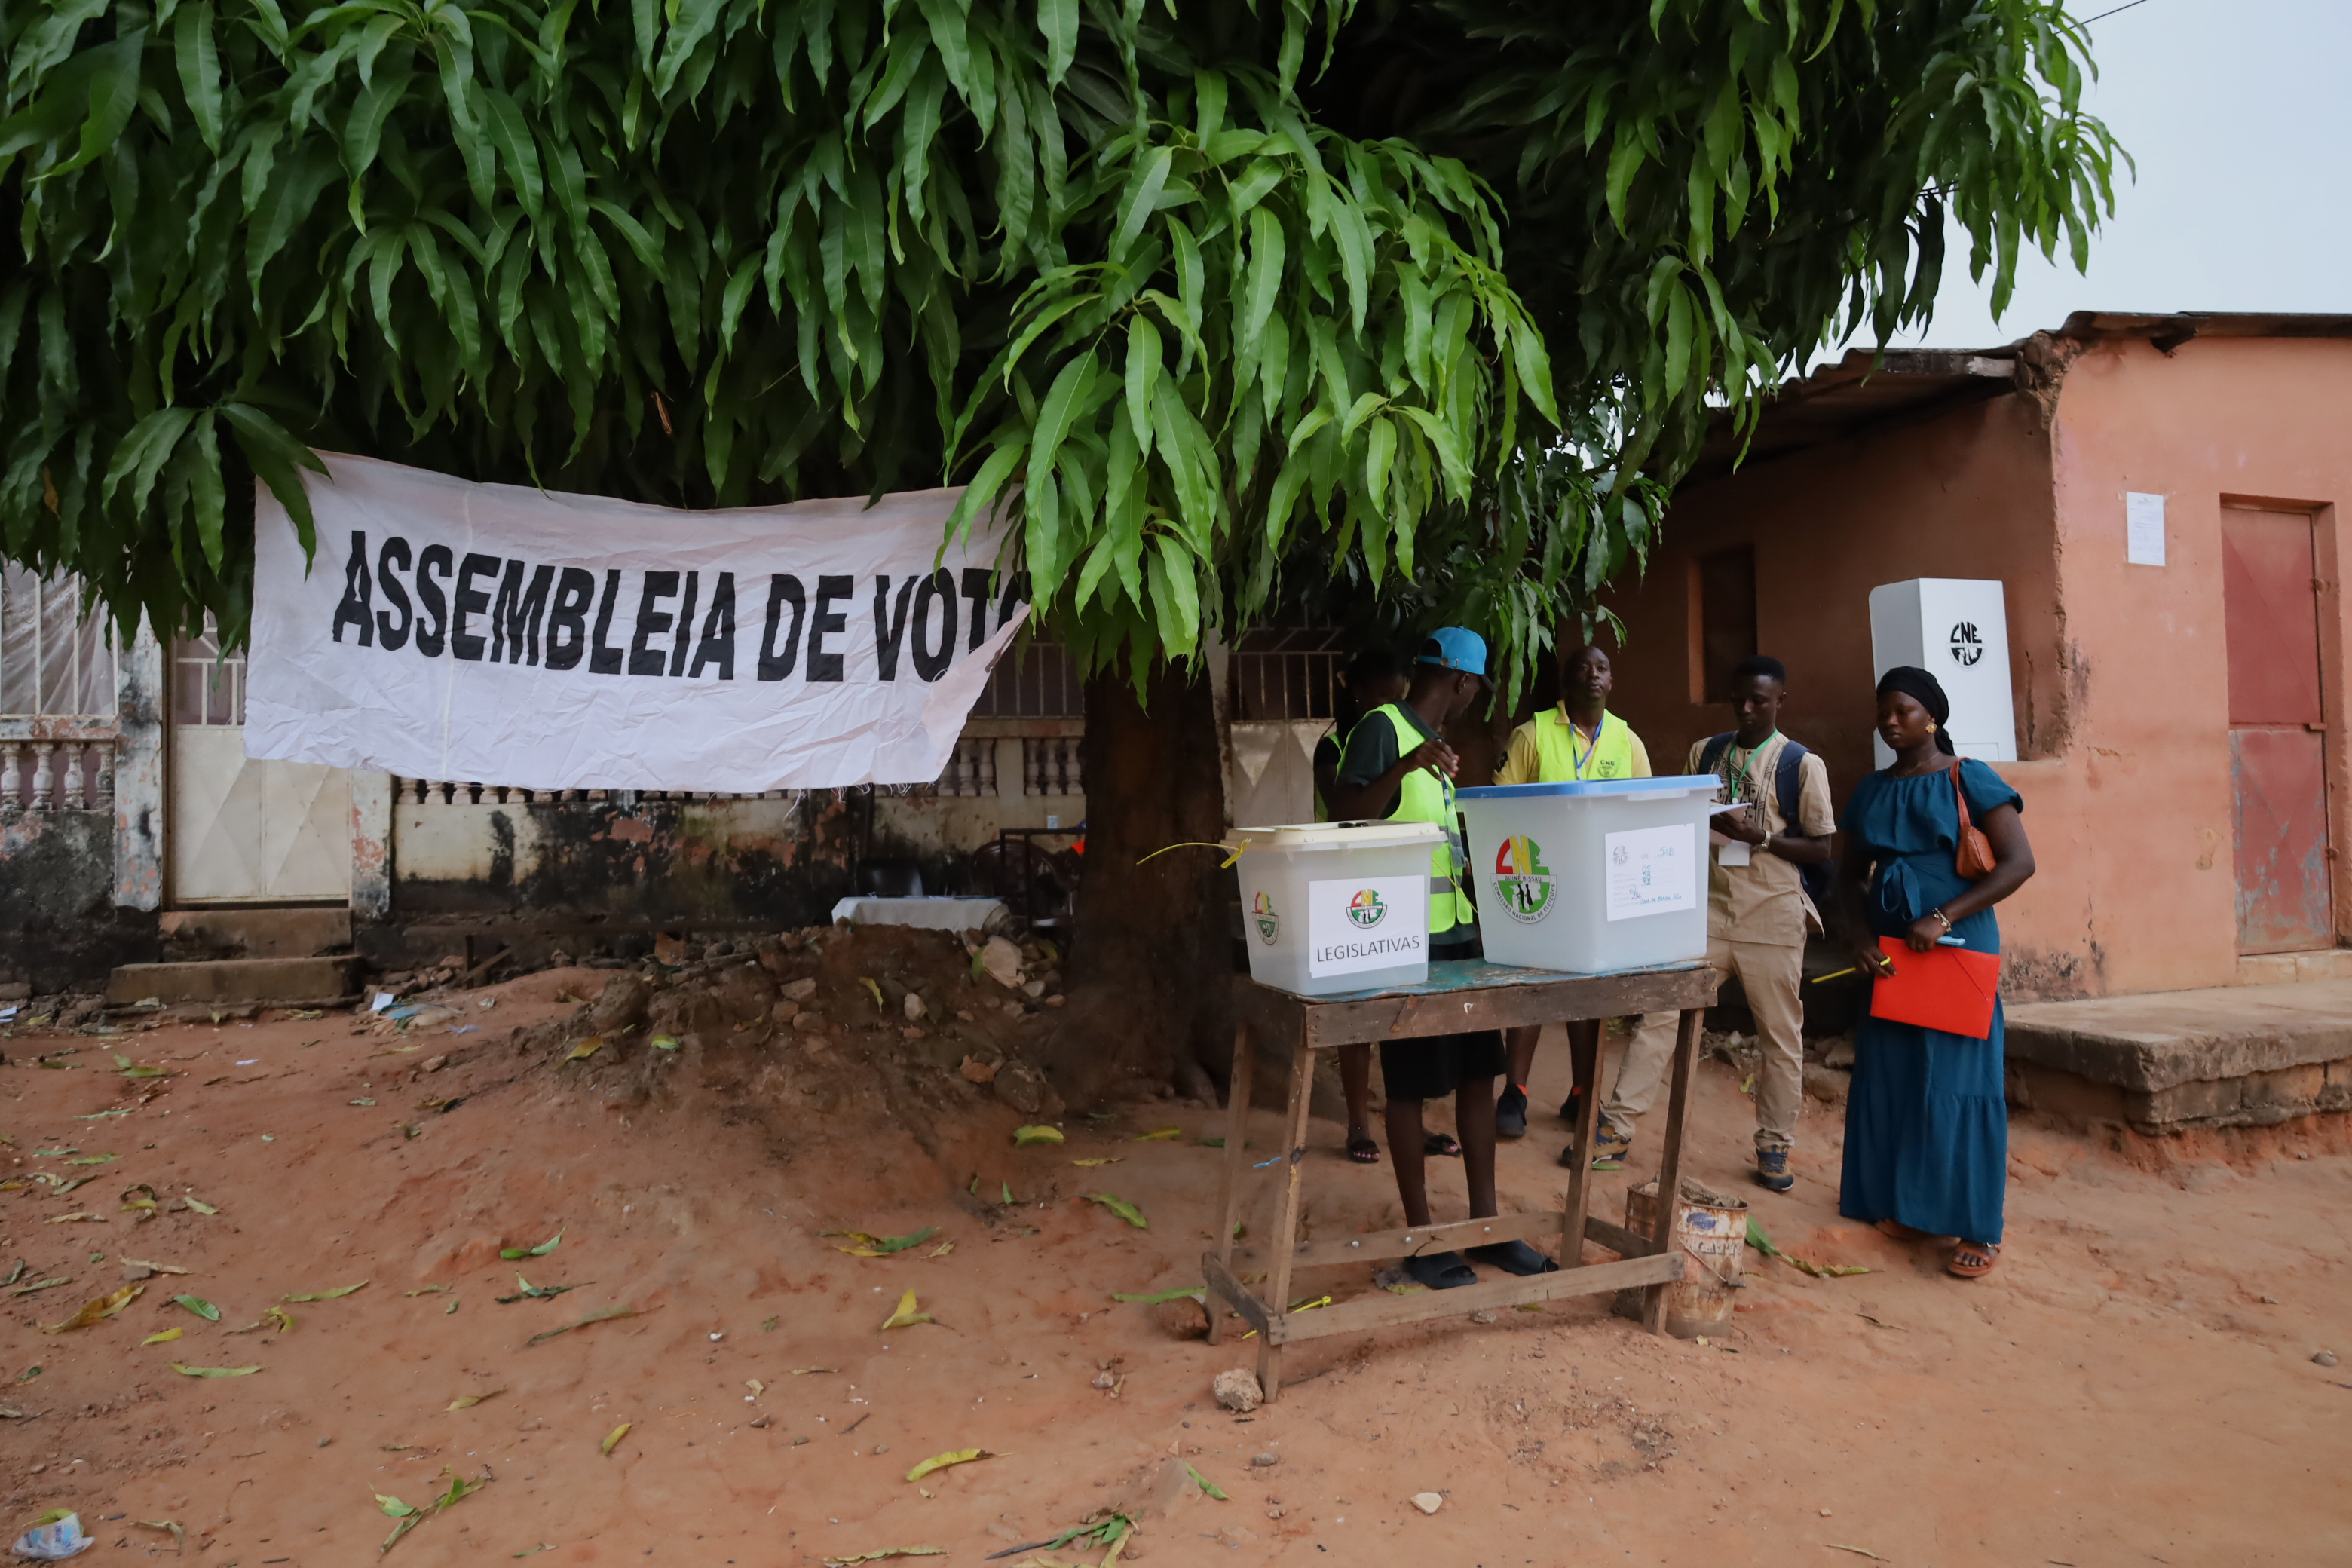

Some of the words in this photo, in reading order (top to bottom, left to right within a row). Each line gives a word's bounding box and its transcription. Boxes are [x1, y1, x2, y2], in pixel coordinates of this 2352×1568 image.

[333, 530, 735, 681] ASSEMBLEIA
[758, 574, 854, 683] DE
[1950, 621, 1982, 643] CNE
[1496, 835, 1550, 875] CNE
[1351, 889, 1383, 907] CNE
[1512, 911, 1536, 921] NACIONAL
[1538, 909, 1544, 917] DE
[1317, 936, 1419, 963] LEGISLATIVAS
